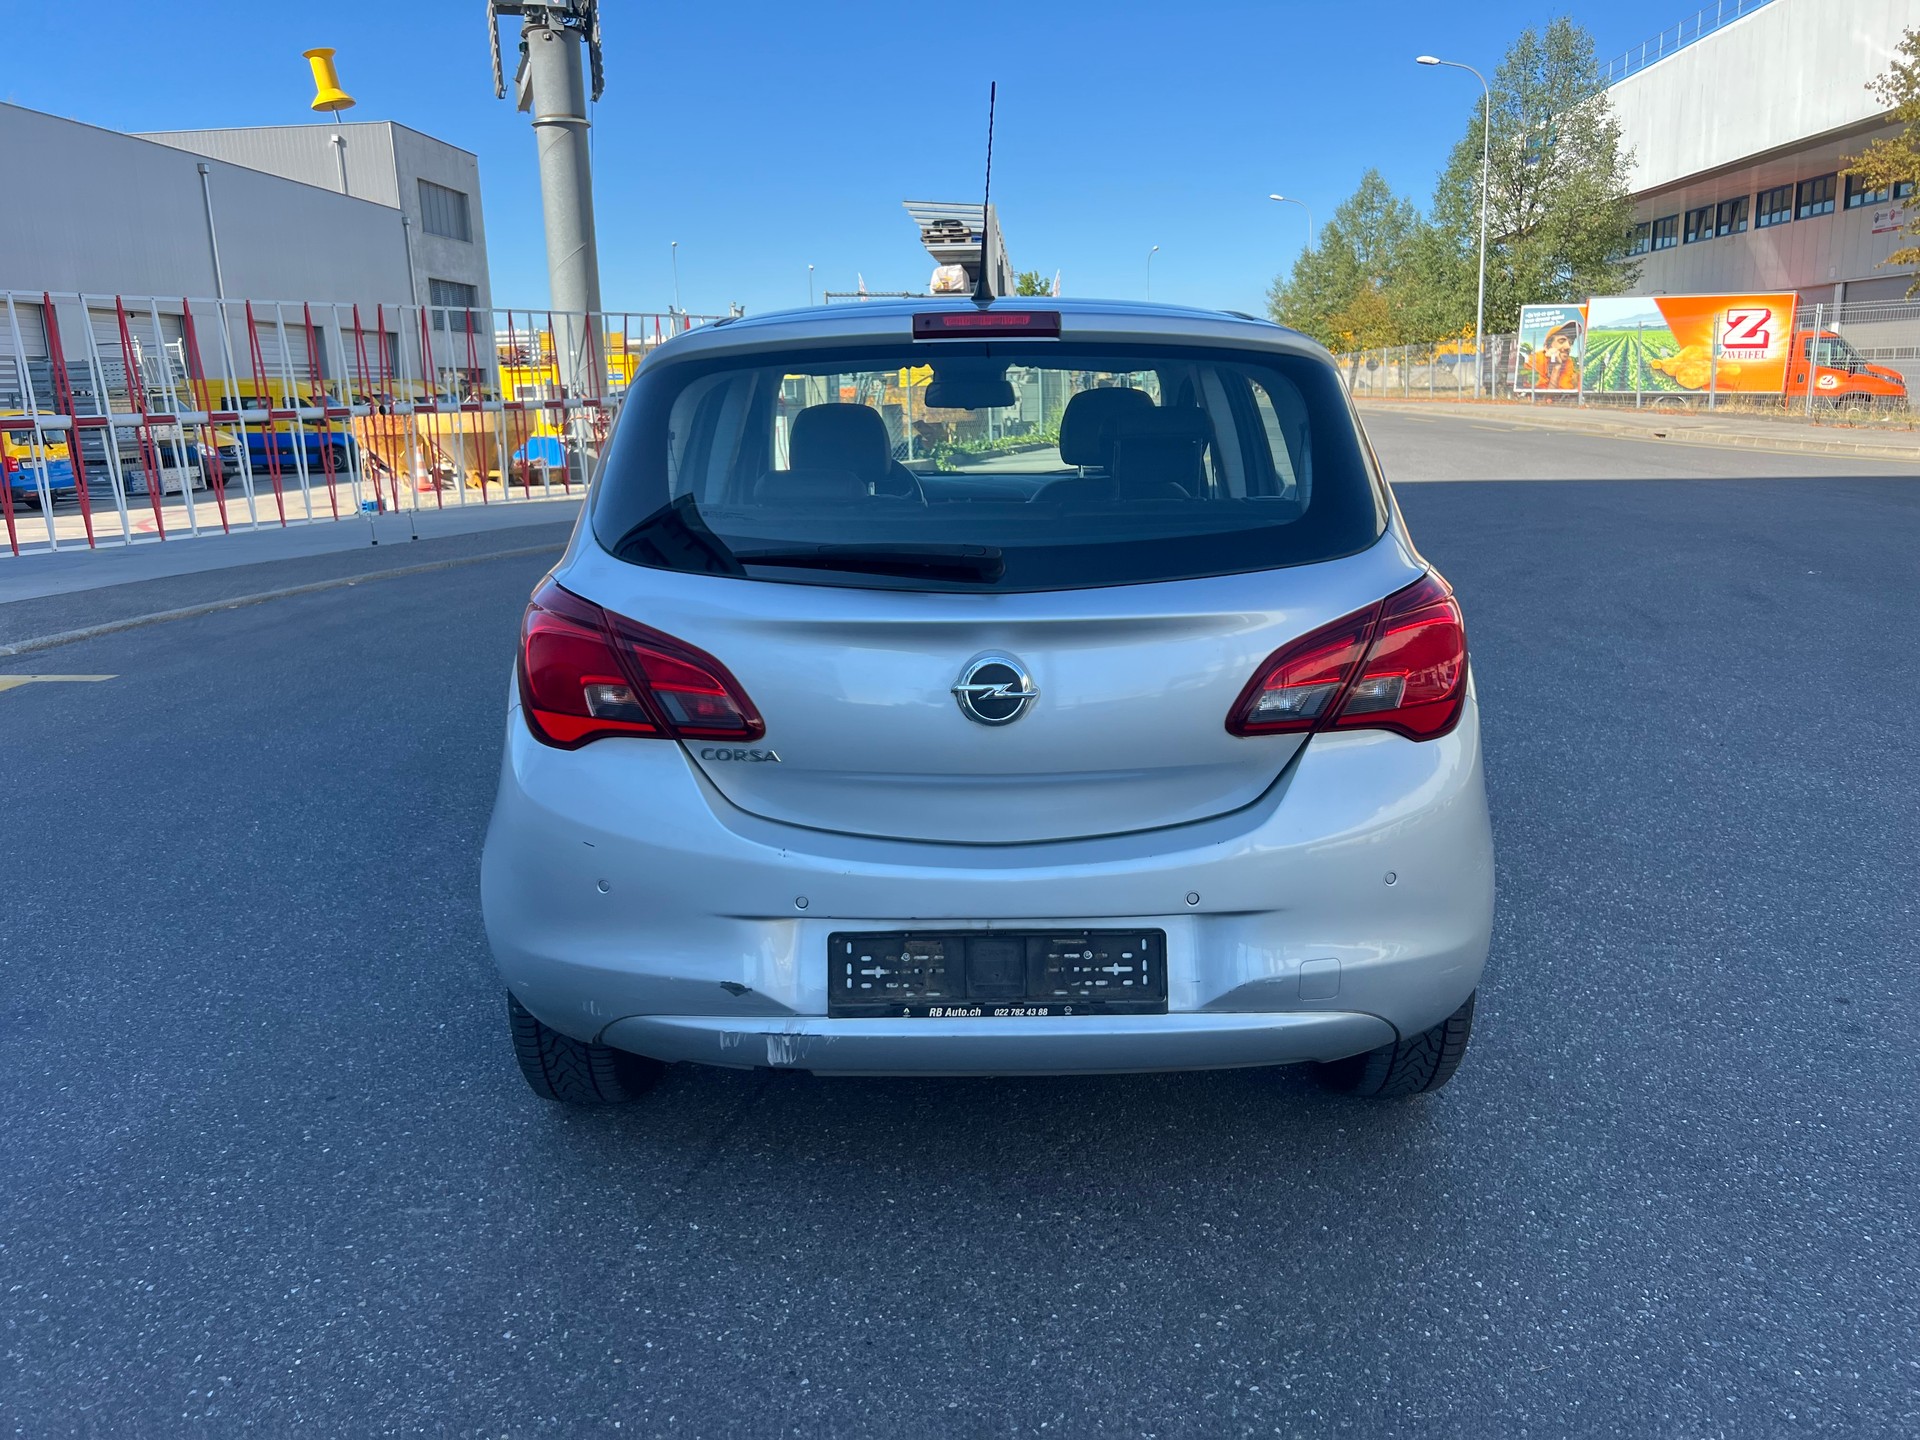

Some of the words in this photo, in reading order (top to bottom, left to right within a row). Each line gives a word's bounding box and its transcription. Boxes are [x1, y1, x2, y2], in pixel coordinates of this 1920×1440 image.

[1723, 308, 1771, 349] Z
[1720, 350, 1768, 360] ZWEIFEL
[700, 747, 782, 763] CORSA
[929, 1007, 943, 1017] RB
[945, 1007, 982, 1017] Auto.ch
[994, 1008, 1009, 1016] 022
[1011, 1008, 1025, 1016] 782
[1026, 1008, 1036, 1016] 43
[1038, 1008, 1048, 1016] 88
